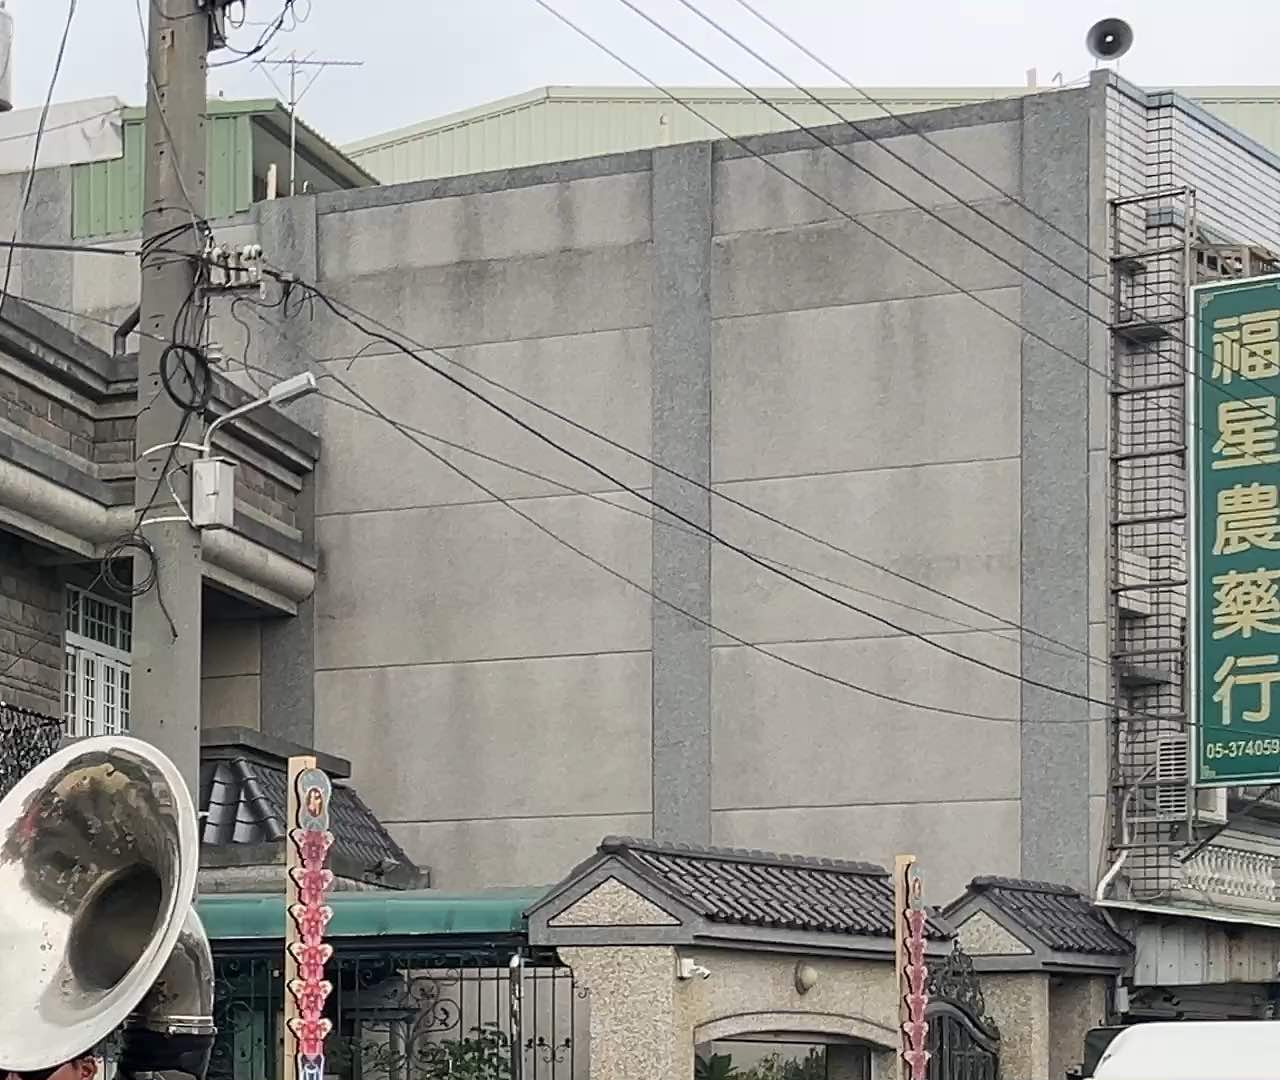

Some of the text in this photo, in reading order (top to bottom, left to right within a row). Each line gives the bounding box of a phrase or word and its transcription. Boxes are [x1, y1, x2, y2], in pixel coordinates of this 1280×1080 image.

[1212, 310, 1280, 725] 福星農藥行
